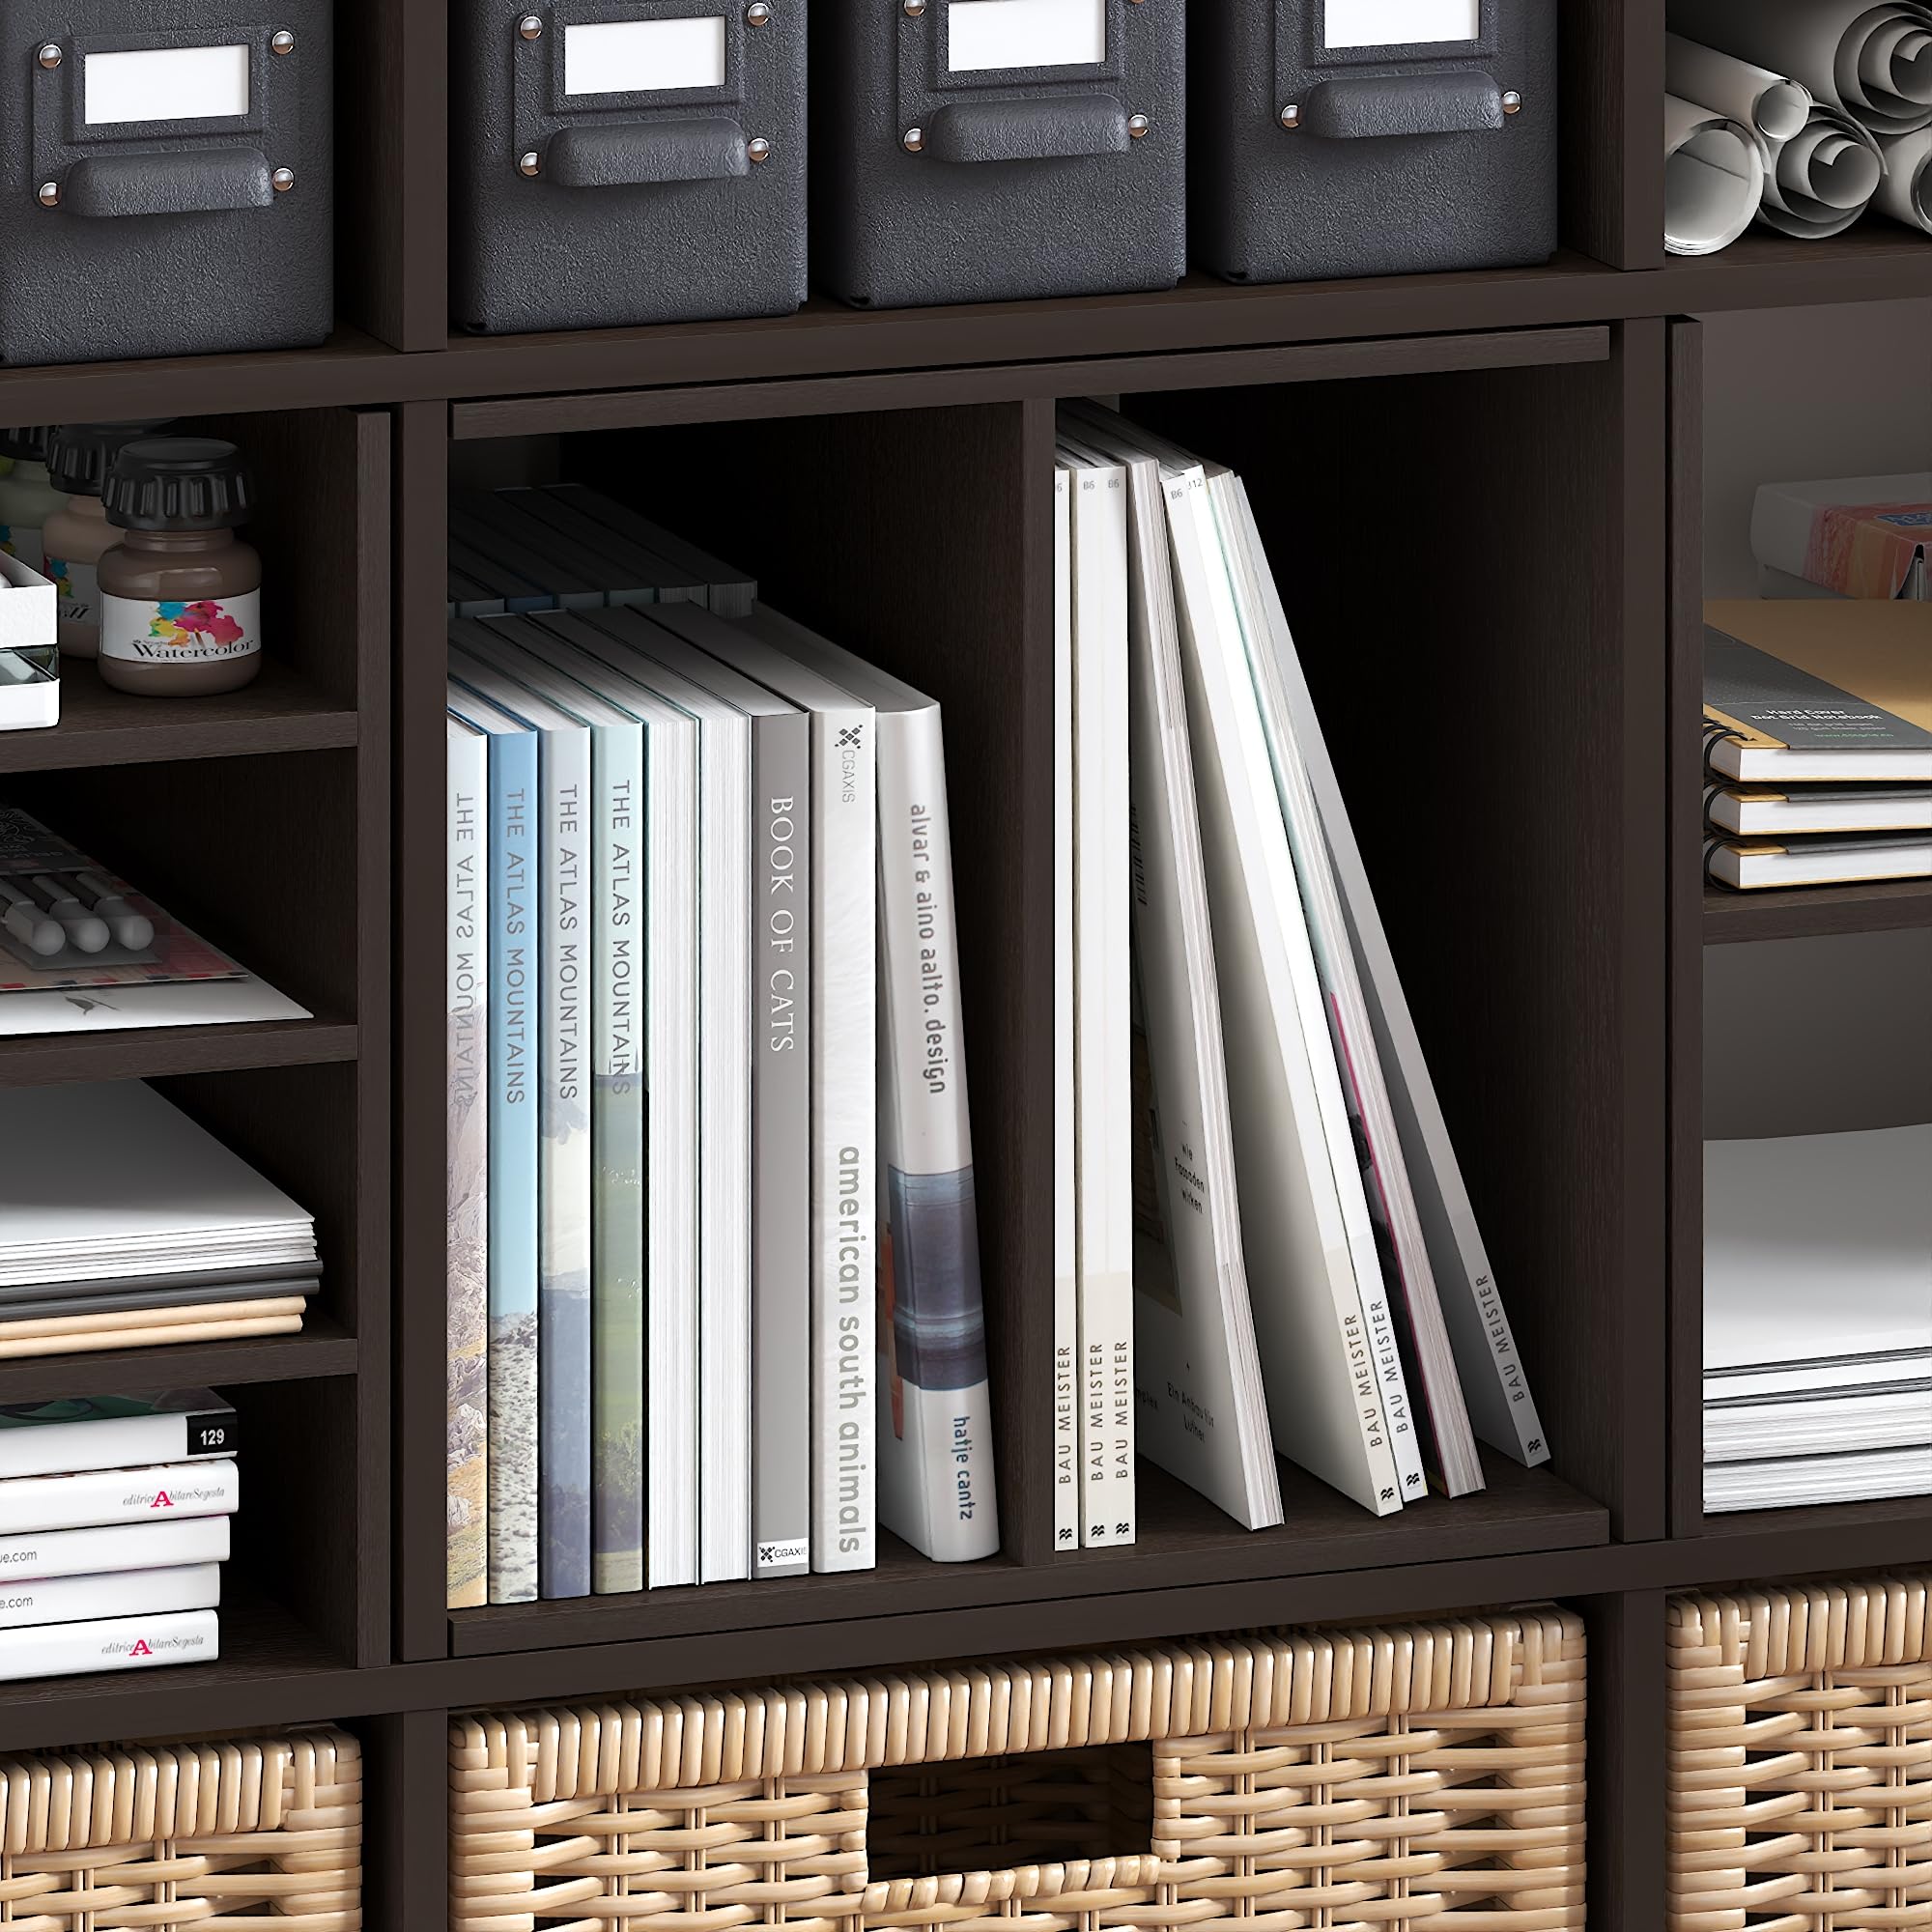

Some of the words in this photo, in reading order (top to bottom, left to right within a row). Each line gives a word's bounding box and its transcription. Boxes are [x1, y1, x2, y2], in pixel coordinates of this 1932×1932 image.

[1083, 480, 1095, 491] B6
[1108, 478, 1120, 489] B6
[1170, 488, 1183, 500] B6
[131, 639, 254, 659] Watercolor
[841, 750, 856, 803] CGAXIS
[506, 788, 526, 838] THE
[559, 784, 578, 834] THE
[612, 780, 631, 829] THE
[770, 796, 794, 895] BOOK
[911, 804, 932, 862] alvar
[506, 851, 526, 935] ATLAS
[559, 848, 578, 930] ATLAS
[612, 843, 631, 926] ATLAS
[916, 870, 931, 883] &
[770, 909, 794, 952] OF
[917, 892, 935, 940] aino
[921, 948, 944, 1014] aalto.
[506, 949, 526, 1104] MOUNTAINS
[559, 945, 578, 1099] MOUNTAINS
[612, 940, 631, 1095] MOUNTAINS
[770, 969, 794, 1053] CATS
[923, 1018, 948, 1094] design
[838, 1146, 867, 1304] american
[1475, 1274, 1511, 1352] MEISTER
[838, 1317, 867, 1409] south
[1344, 1314, 1374, 1397] MEISTER
[1370, 1300, 1399, 1383] MEISTER
[1057, 1347, 1070, 1431] MEISTER
[1090, 1344, 1103, 1428] MEISTER
[1114, 1341, 1128, 1426] MEISTER
[1501, 1364, 1525, 1403] BAU
[200, 1428, 225, 1445] 129
[953, 1415, 971, 1463] hatje
[1364, 1406, 1382, 1447] BAU
[1390, 1394, 1409, 1434] BAU
[1059, 1444, 1070, 1484] BAU
[1091, 1441, 1103, 1481] BAU
[1115, 1439, 1128, 1479] BAU
[838, 1421, 867, 1553] animals
[957, 1470, 975, 1520] cantz
